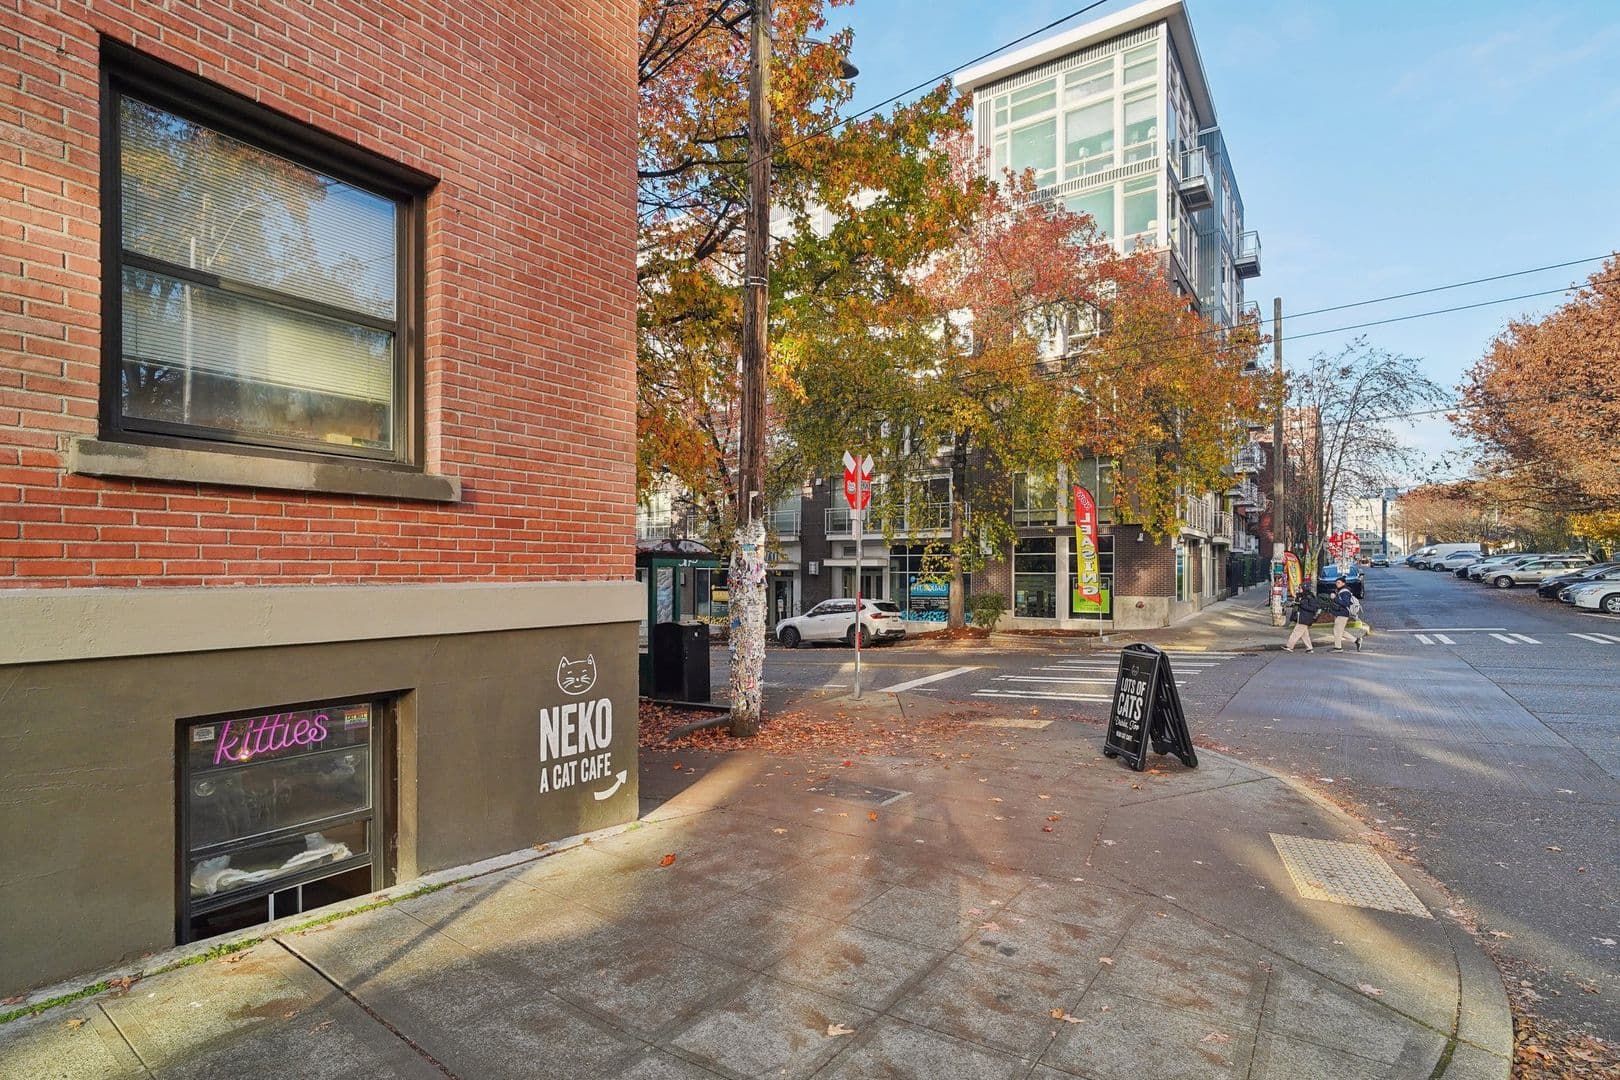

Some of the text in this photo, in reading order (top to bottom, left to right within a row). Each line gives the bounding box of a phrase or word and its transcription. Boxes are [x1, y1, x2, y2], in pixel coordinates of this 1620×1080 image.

[1117, 692, 1144, 721] CATS
[1120, 677, 1147, 697] LOTS OF
[213, 712, 329, 765] kitties
[540, 698, 612, 762] NEKO
[539, 752, 612, 794] A CAT CAFE
